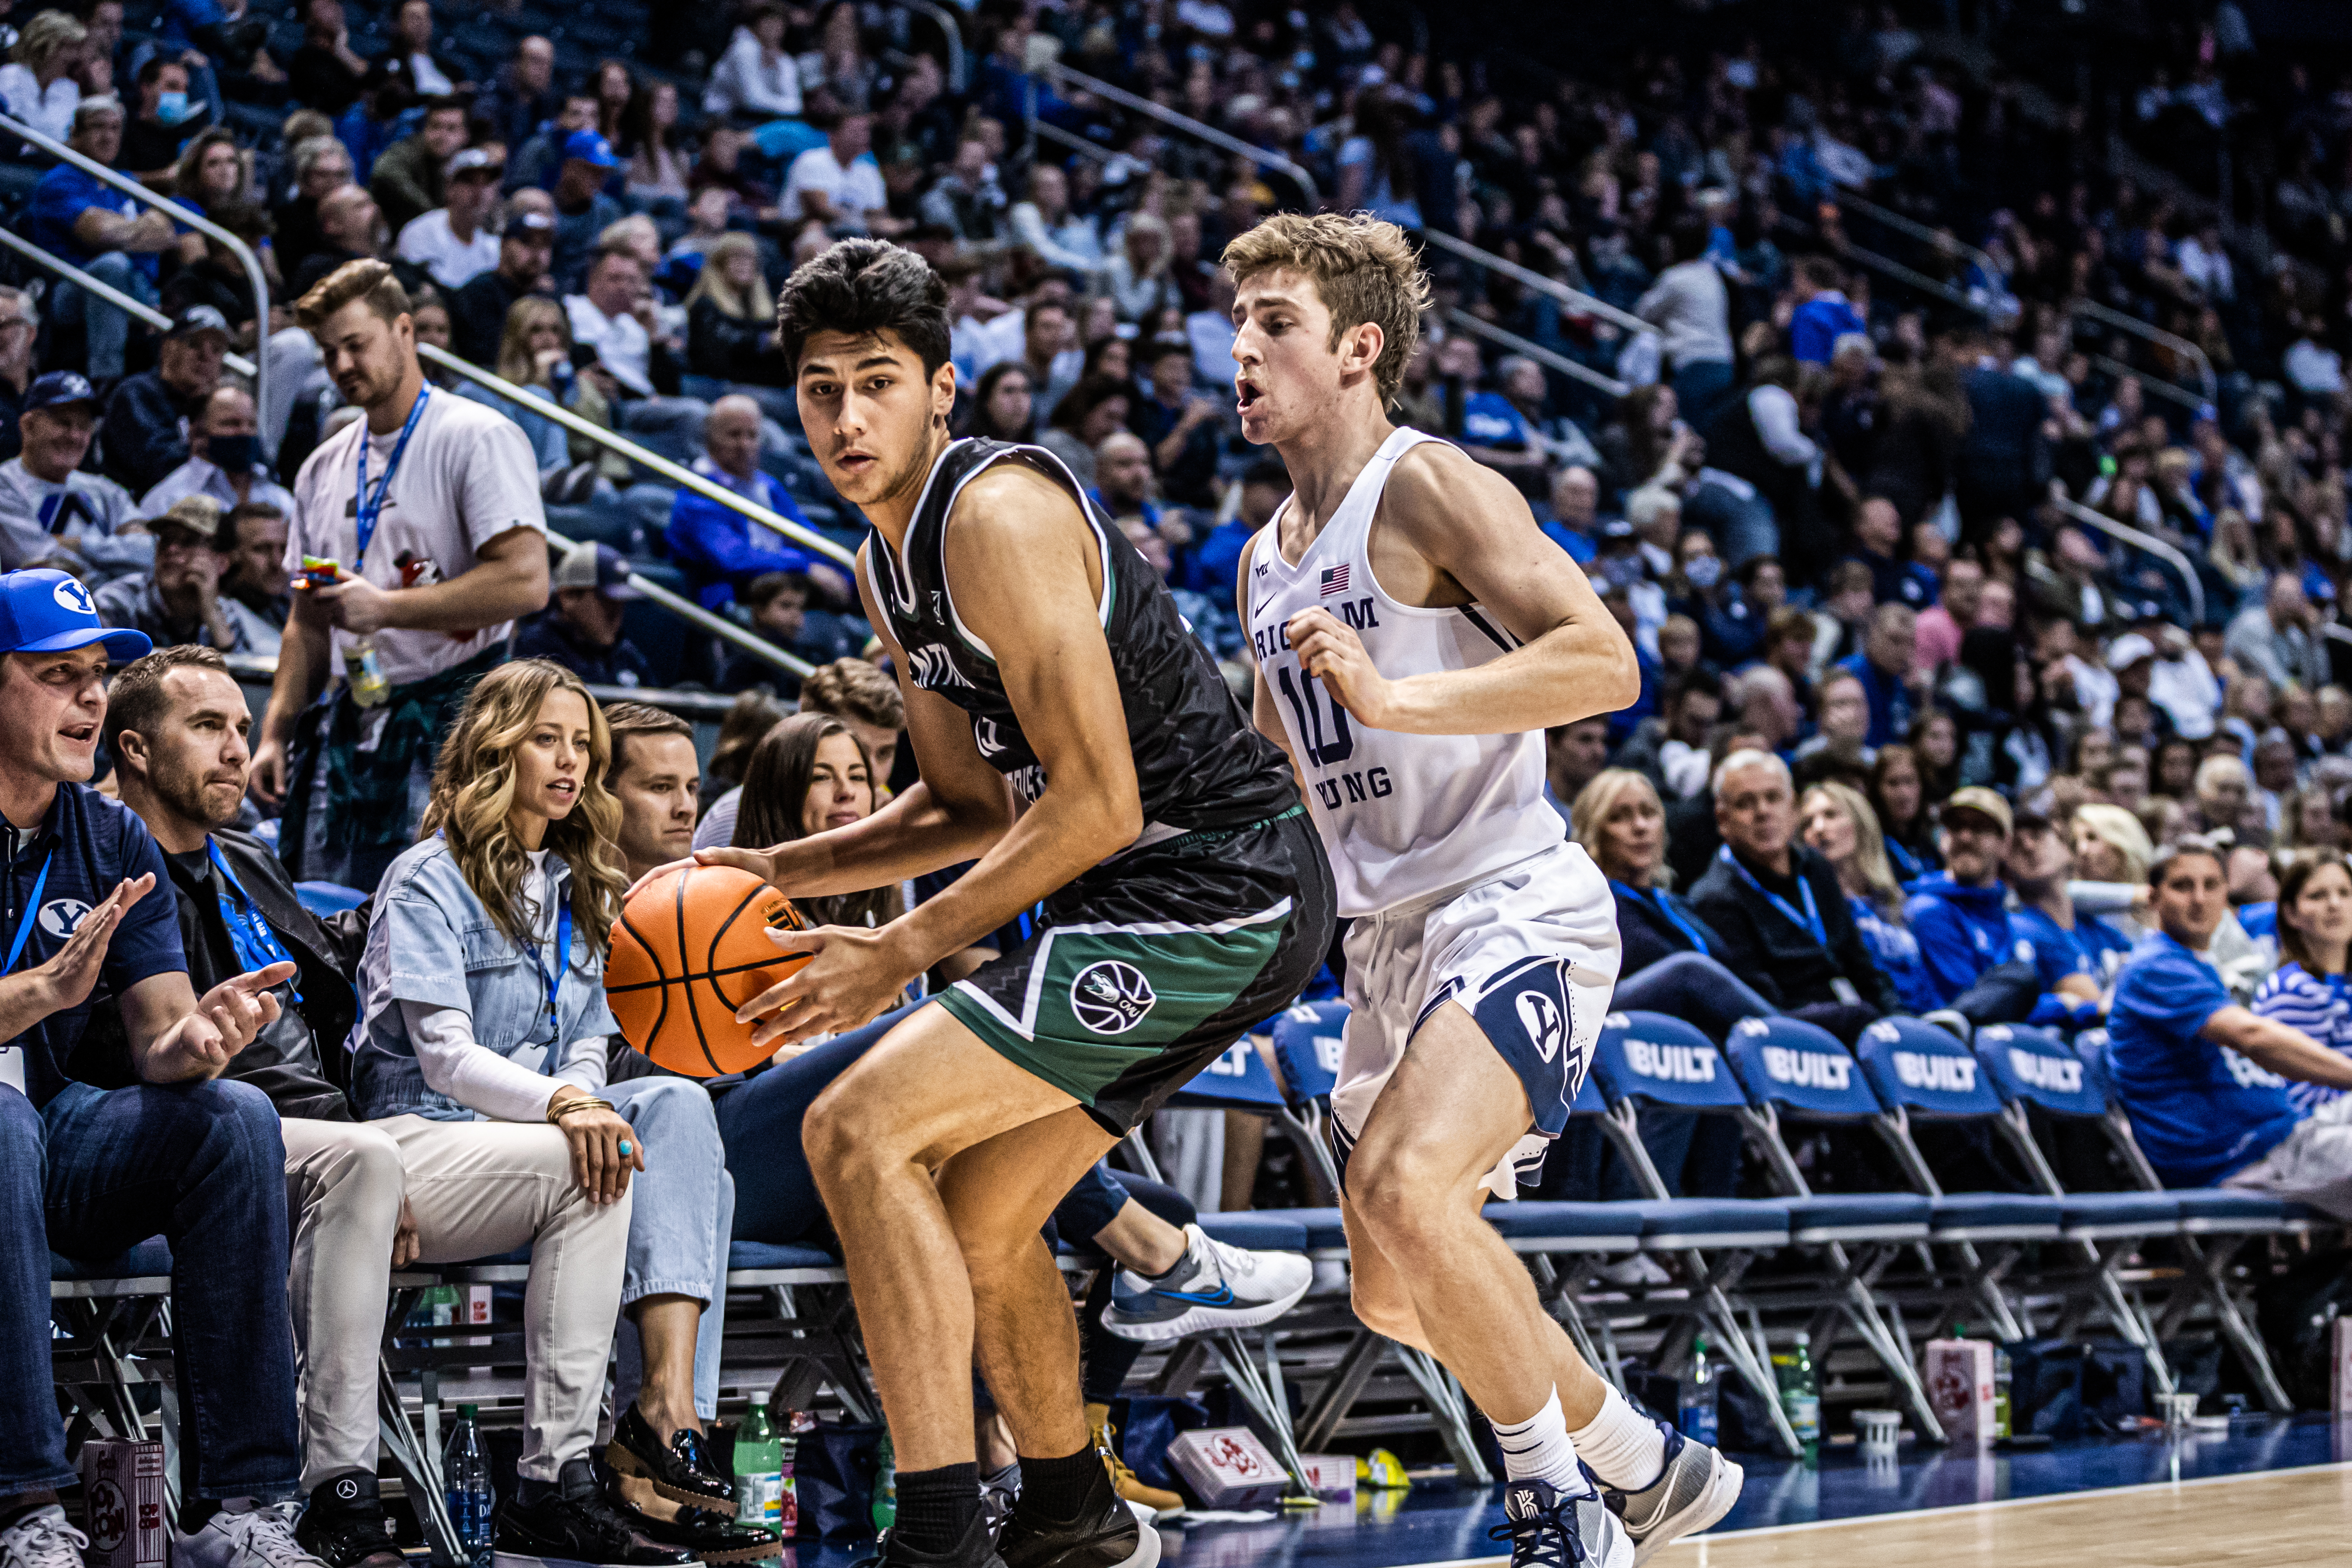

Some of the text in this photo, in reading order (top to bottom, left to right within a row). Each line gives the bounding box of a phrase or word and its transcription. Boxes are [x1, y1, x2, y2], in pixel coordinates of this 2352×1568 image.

[59, 582, 91, 611] Y
[1278, 666, 1353, 767] 10
[47, 902, 90, 934] Y
[1119, 1000, 1140, 1018] CMU
[1525, 994, 1560, 1056] Y
[1623, 1039, 1718, 1082] BUILT
[1762, 1046, 1854, 1091] BUILT
[1892, 1051, 1977, 1092] BUILT
[2008, 1048, 2084, 1093] BUILT
[90, 1484, 115, 1517] POP
[139, 1503, 159, 1517] POP
[92, 1507, 125, 1541] CORN
